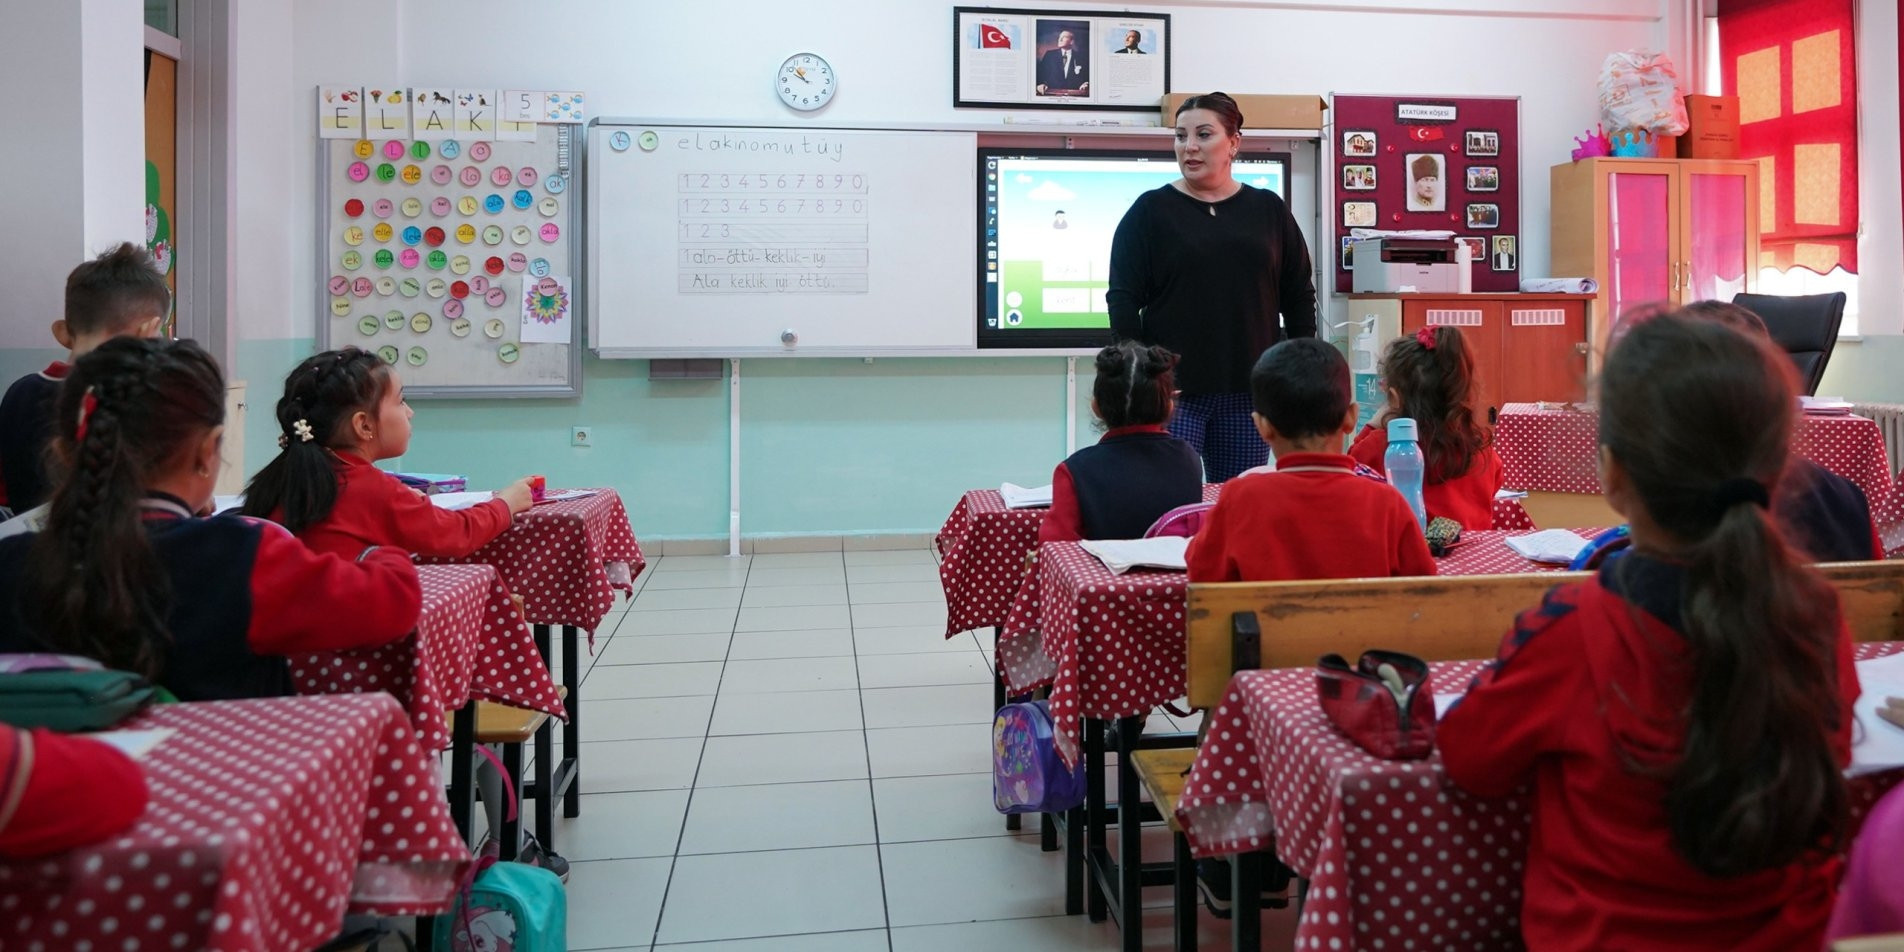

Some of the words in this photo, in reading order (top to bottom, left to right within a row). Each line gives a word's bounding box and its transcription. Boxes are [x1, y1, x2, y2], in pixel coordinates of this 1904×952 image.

[521, 93, 530, 110] 5
[336, 107, 348, 128] E
[382, 108, 394, 129] L
[426, 110, 444, 130] A
[470, 110, 482, 131] K
[683, 174, 689, 188] 1
[701, 174, 710, 188] 2
[721, 174, 730, 188] 3
[739, 174, 749, 188] 4
[760, 174, 768, 188] 5
[778, 174, 786, 188] 6
[797, 174, 805, 188] 7
[817, 174, 824, 188] 8
[834, 174, 842, 188] 9
[852, 174, 862, 188] 0
[683, 199, 689, 213] 1
[701, 199, 710, 213] 2
[721, 199, 730, 213] 3
[739, 199, 749, 213] 4
[760, 199, 768, 213] 5
[778, 199, 786, 213] 6
[797, 199, 805, 213] 7
[817, 199, 824, 213] 8
[834, 199, 842, 213] 9
[852, 199, 862, 213] 0
[684, 224, 689, 238] 1
[701, 224, 710, 238] 2
[721, 224, 729, 238] 3
[693, 274, 720, 288] Ala
[730, 273, 767, 288] keklik
[1366, 378, 1376, 396] 14
